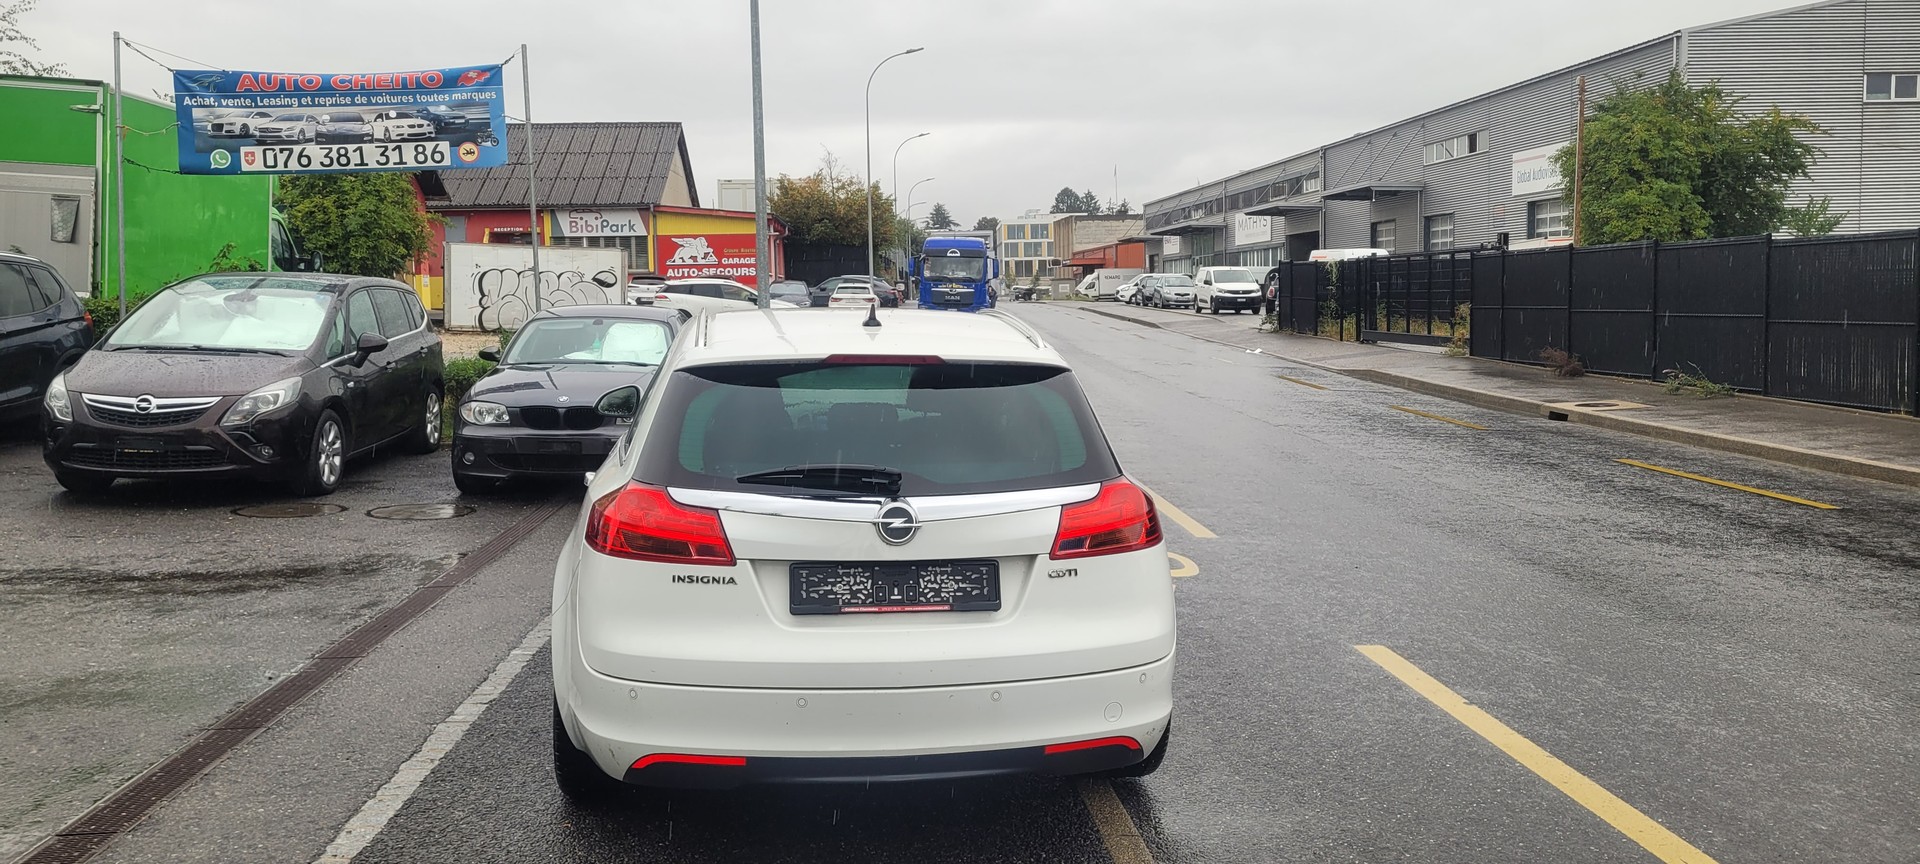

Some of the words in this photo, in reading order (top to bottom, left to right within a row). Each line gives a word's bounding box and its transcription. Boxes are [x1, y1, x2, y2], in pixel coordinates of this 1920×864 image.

[236, 73, 322, 92] AUTO
[330, 71, 443, 90] CHEITO
[183, 95, 218, 107] Achat,
[221, 97, 255, 107] vente,
[257, 96, 298, 107] Leasing
[301, 96, 312, 105] et
[315, 94, 351, 107] reprise
[355, 94, 367, 104] de
[370, 93, 414, 104] voitures
[416, 92, 450, 103] toutes
[452, 90, 497, 103] marques
[262, 146, 312, 169] 076
[319, 145, 369, 168] 381
[375, 144, 407, 166] 31
[413, 143, 445, 165] 86
[1517, 168, 1532, 184] Global
[569, 219, 637, 234] BibiPark
[1237, 216, 1268, 231] MATHYS
[722, 257, 756, 265] GARAGE
[666, 267, 756, 277] AUTO-SECOURS
[672, 574, 738, 585] INSIGNIA
[1048, 569, 1078, 578] CDTI
